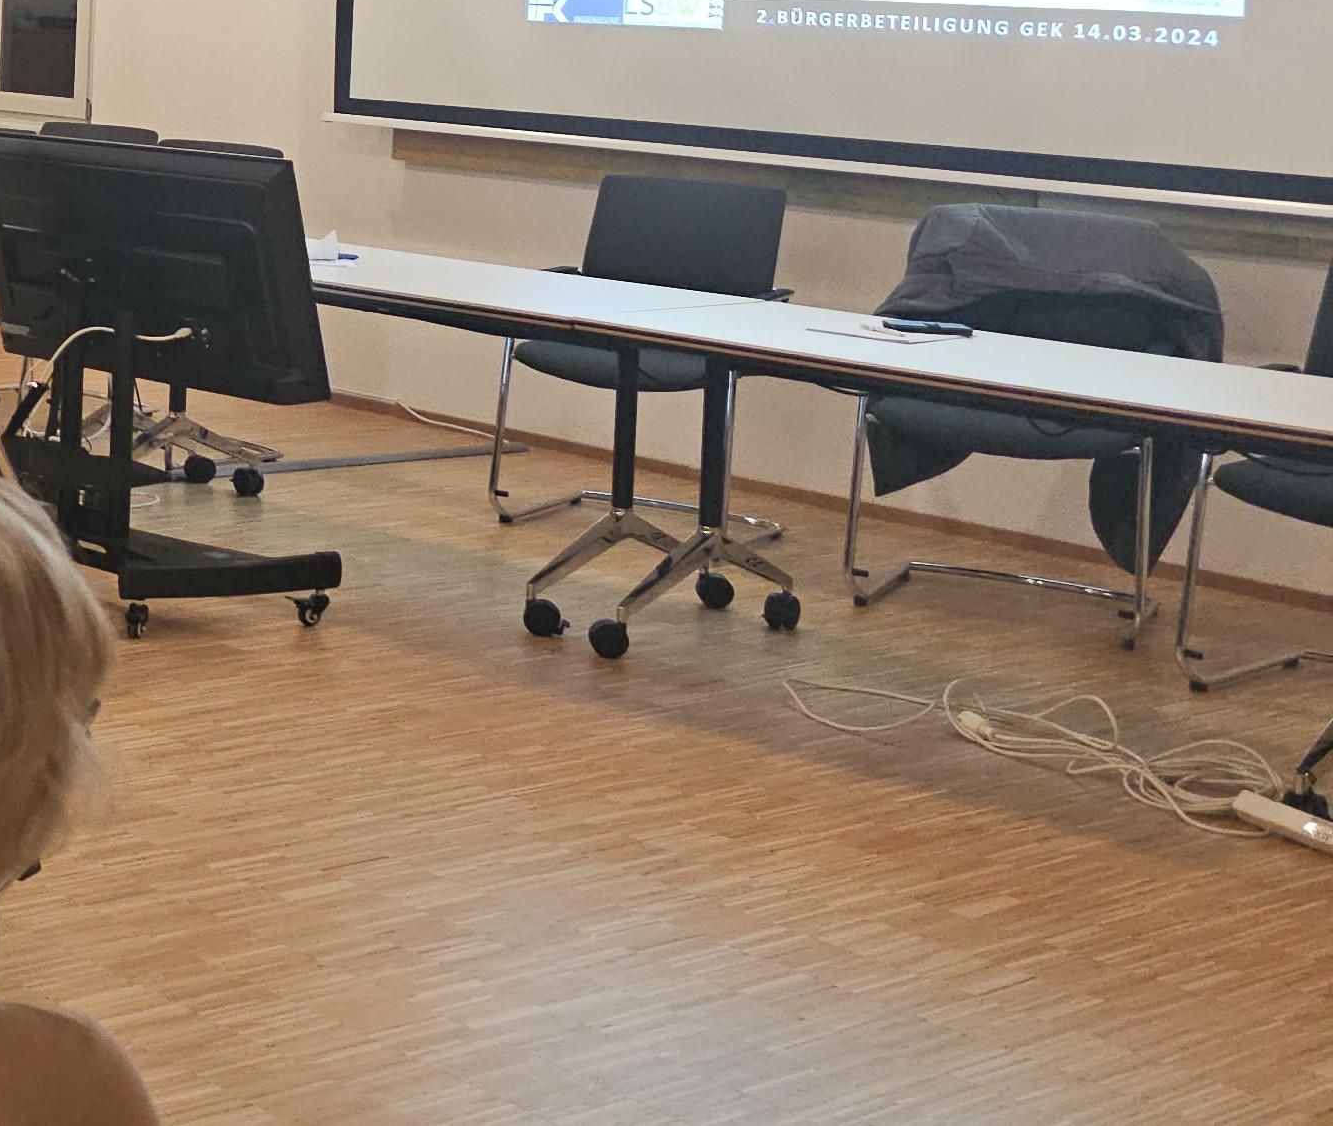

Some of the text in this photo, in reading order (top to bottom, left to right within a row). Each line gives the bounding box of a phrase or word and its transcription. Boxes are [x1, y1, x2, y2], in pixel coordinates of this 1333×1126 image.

[756, 7, 1220, 47] 2.BÜRGERBETEILIGUNG GEK 14.03.2024
